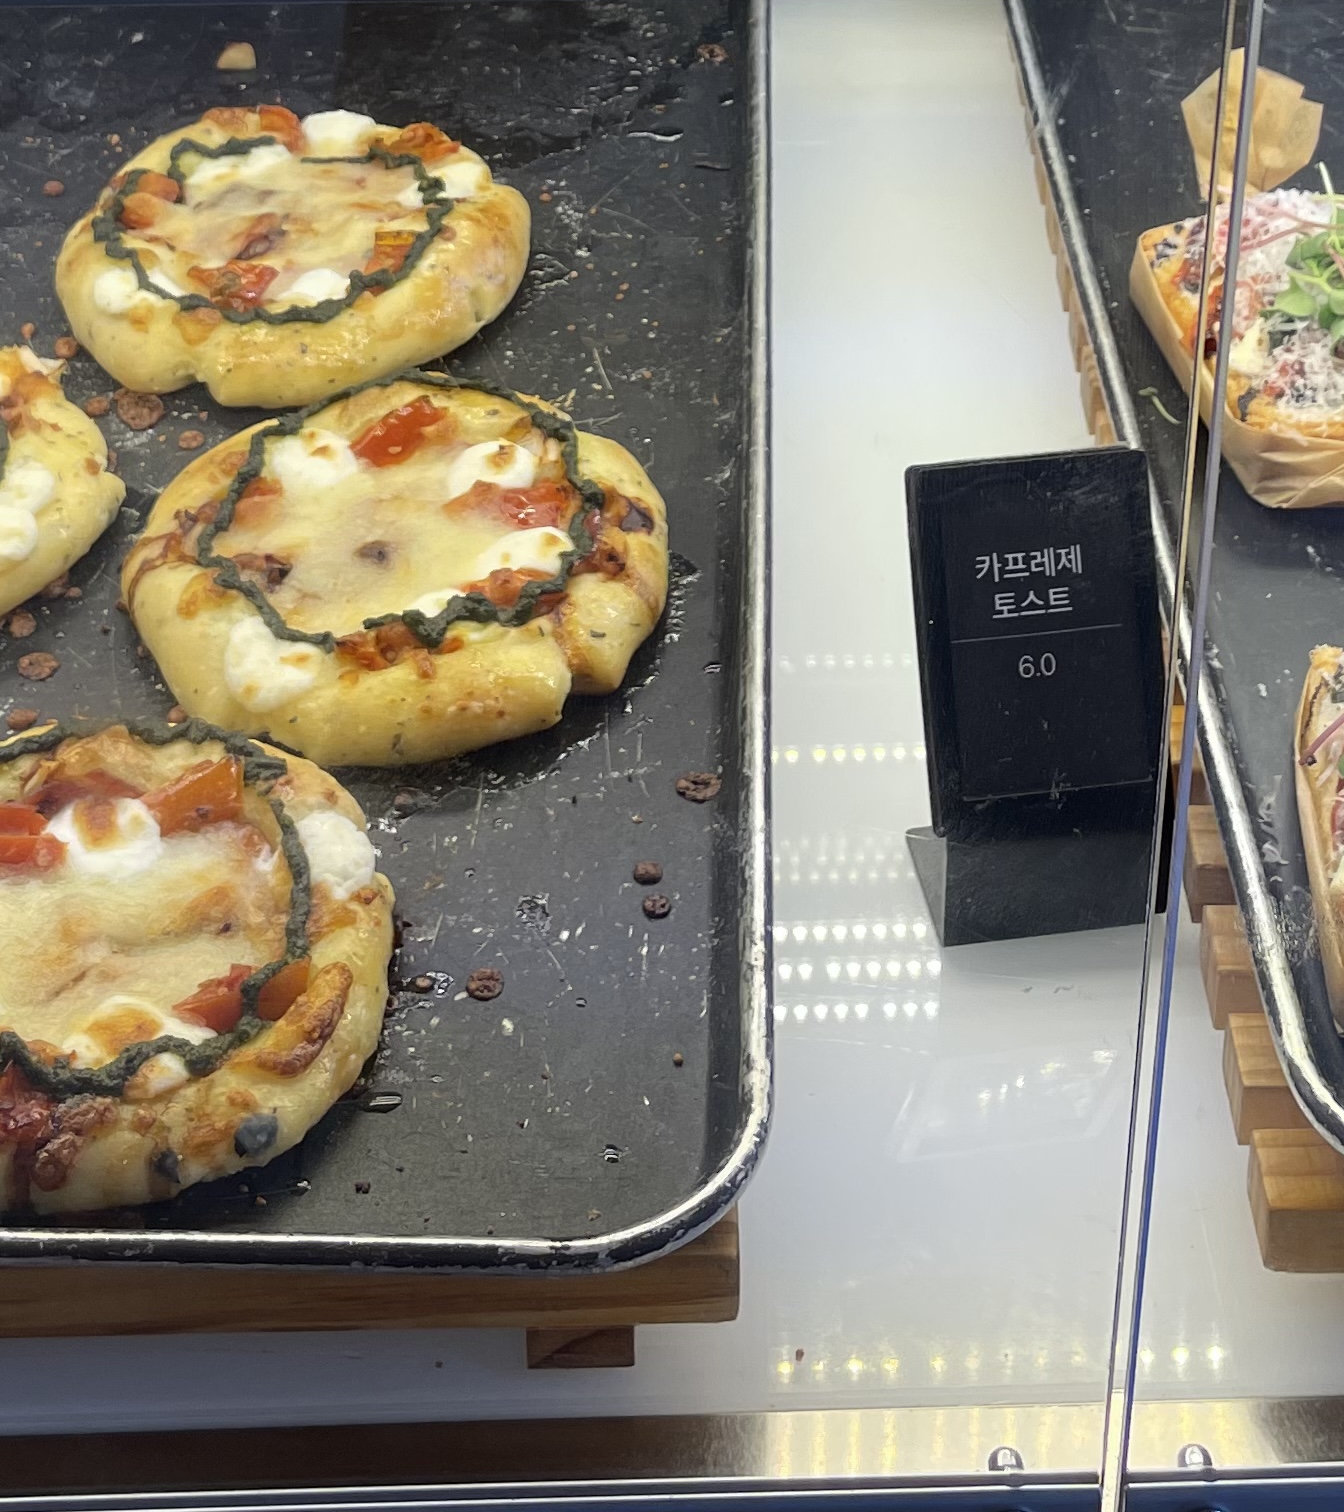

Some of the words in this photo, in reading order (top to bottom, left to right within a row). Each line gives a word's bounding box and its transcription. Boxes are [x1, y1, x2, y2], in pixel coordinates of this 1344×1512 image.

[974, 543, 1084, 583] 카프레제
[991, 586, 1074, 620] 토스트
[1017, 652, 1058, 679] 6.0
